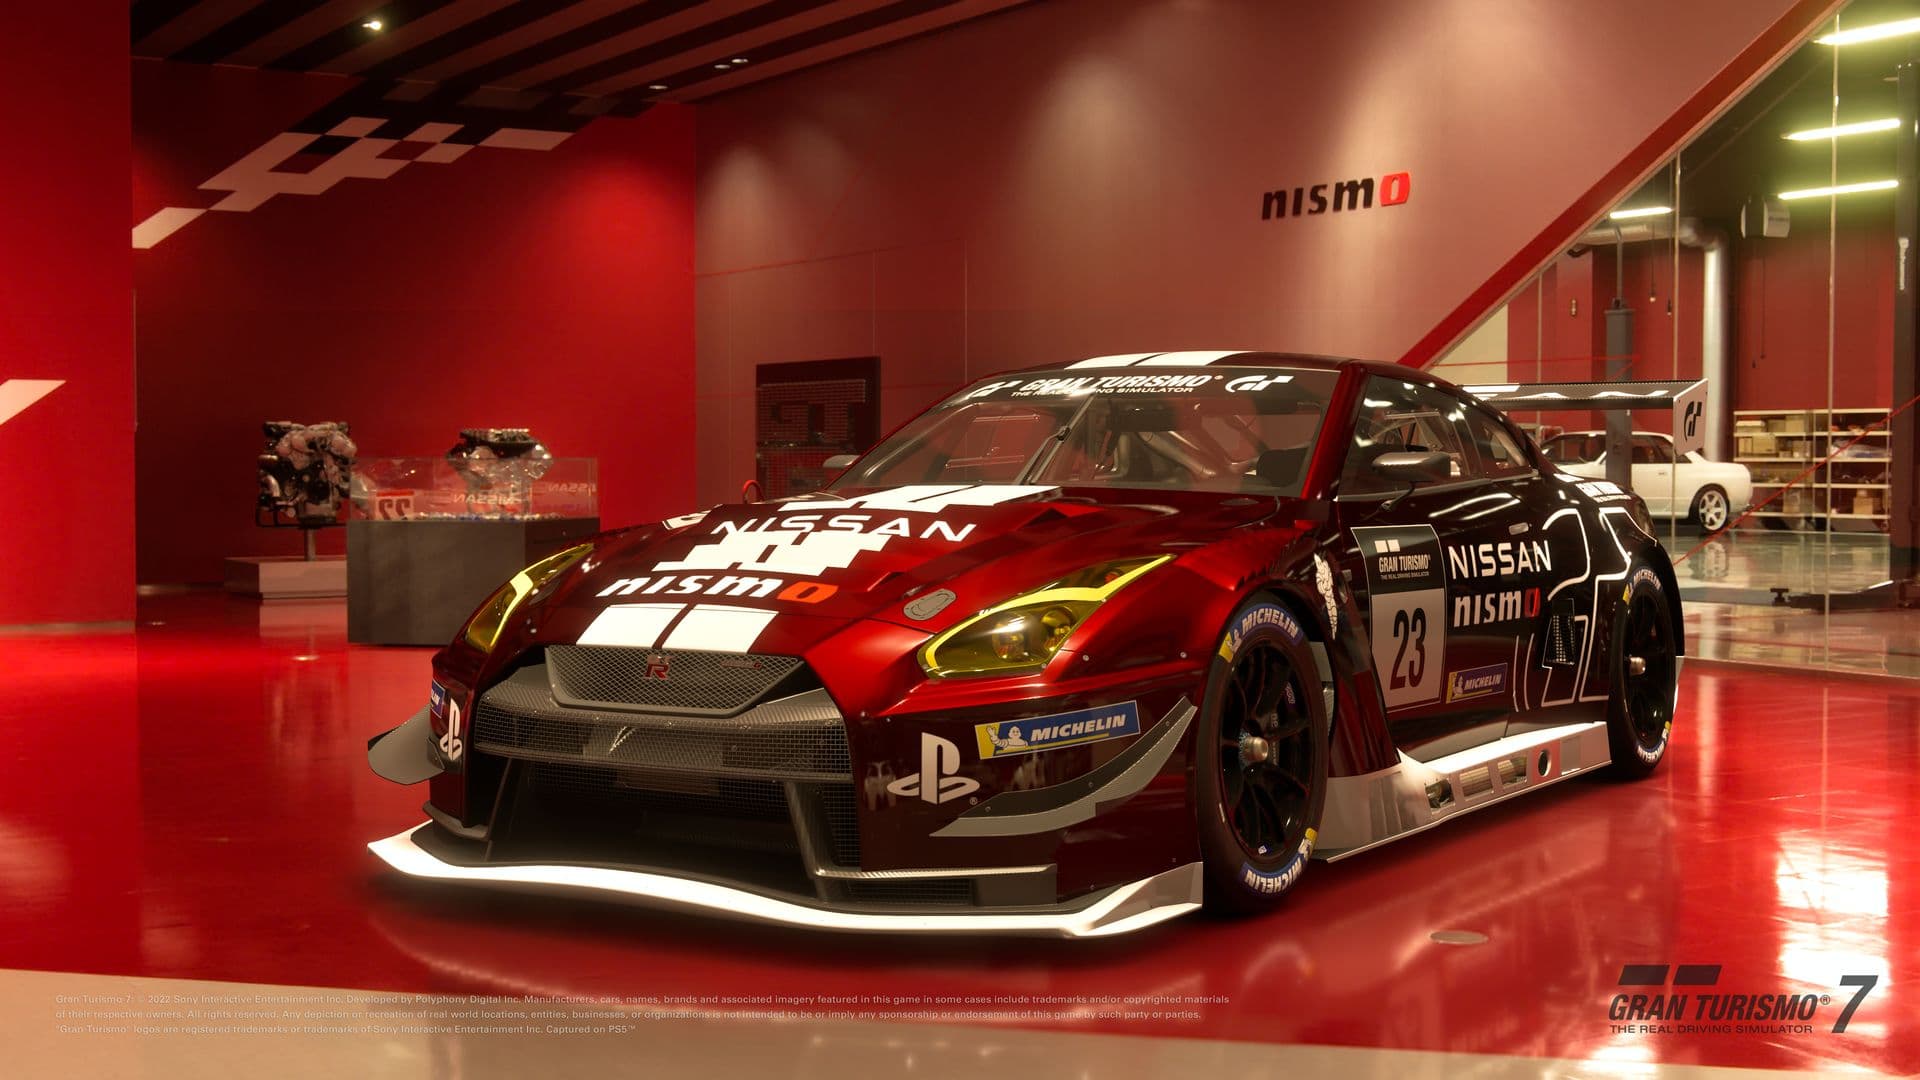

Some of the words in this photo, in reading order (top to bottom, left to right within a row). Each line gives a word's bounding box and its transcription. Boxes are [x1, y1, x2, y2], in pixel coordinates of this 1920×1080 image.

[1261, 172, 1411, 220] nismo
[710, 514, 977, 542] NISSAN
[1379, 556, 1398, 573] GRAN
[1448, 540, 1552, 580] NISSAN
[595, 575, 839, 604] nismo
[1633, 568, 1663, 591] MICHELIN
[1241, 607, 1299, 638] MICHELIN
[1453, 587, 1541, 628] nismo
[1389, 607, 1427, 690] 23
[1464, 674, 1502, 690] MICHELIN
[1031, 714, 1127, 742] MICHELIN
[1245, 857, 1303, 894] MICHELIN
